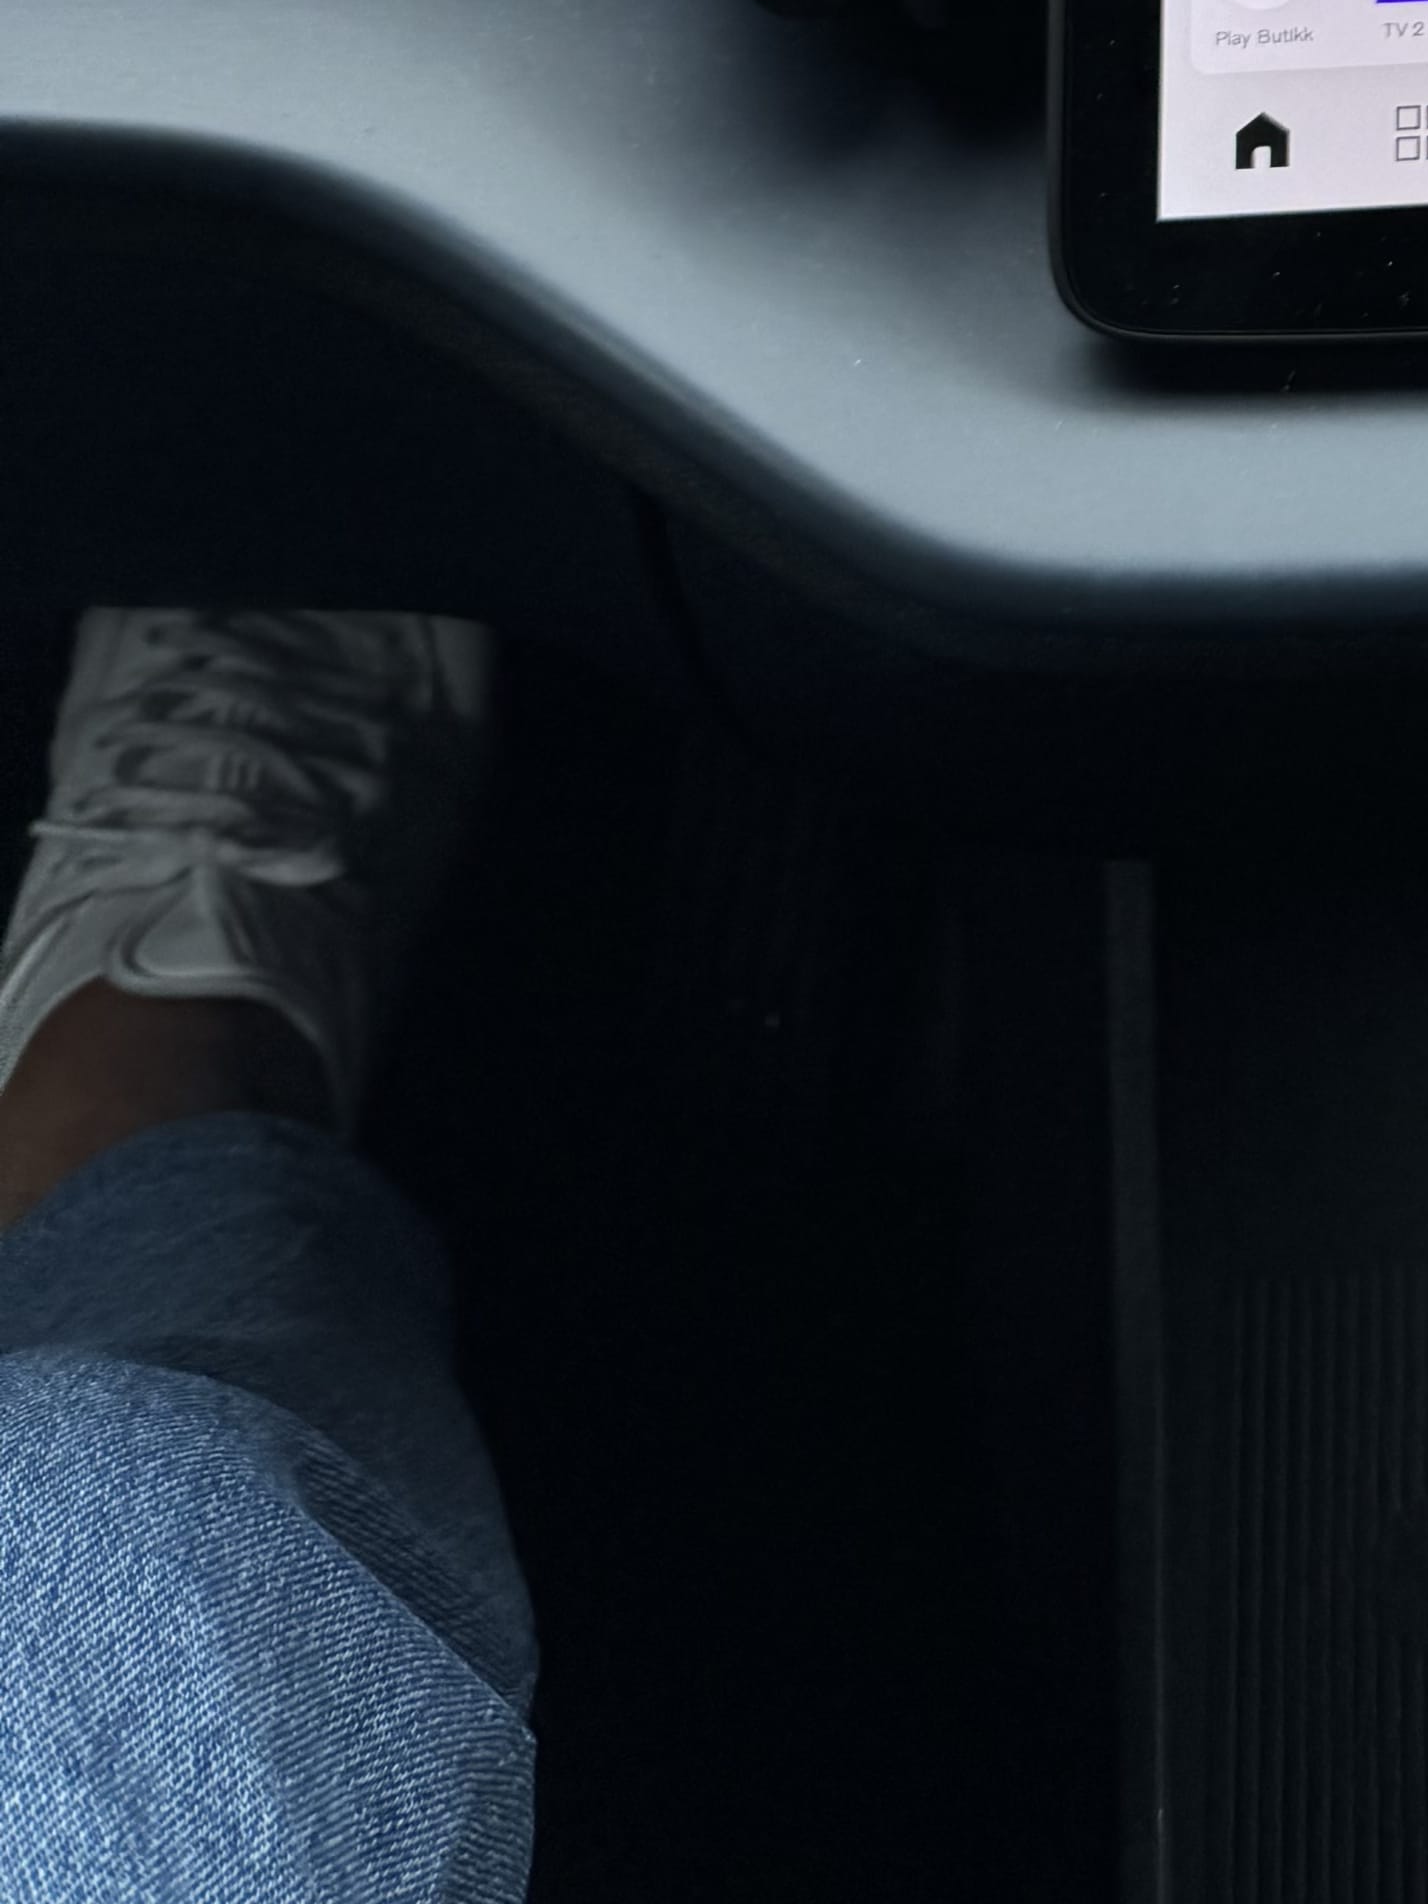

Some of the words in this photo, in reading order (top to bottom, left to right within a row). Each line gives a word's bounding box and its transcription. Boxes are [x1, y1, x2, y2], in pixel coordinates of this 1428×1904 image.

[1215, 30, 1251, 49] Play
[1257, 26, 1315, 45] Butikk
[1382, 21, 1411, 39] TV
[1411, 21, 1426, 38] 2
